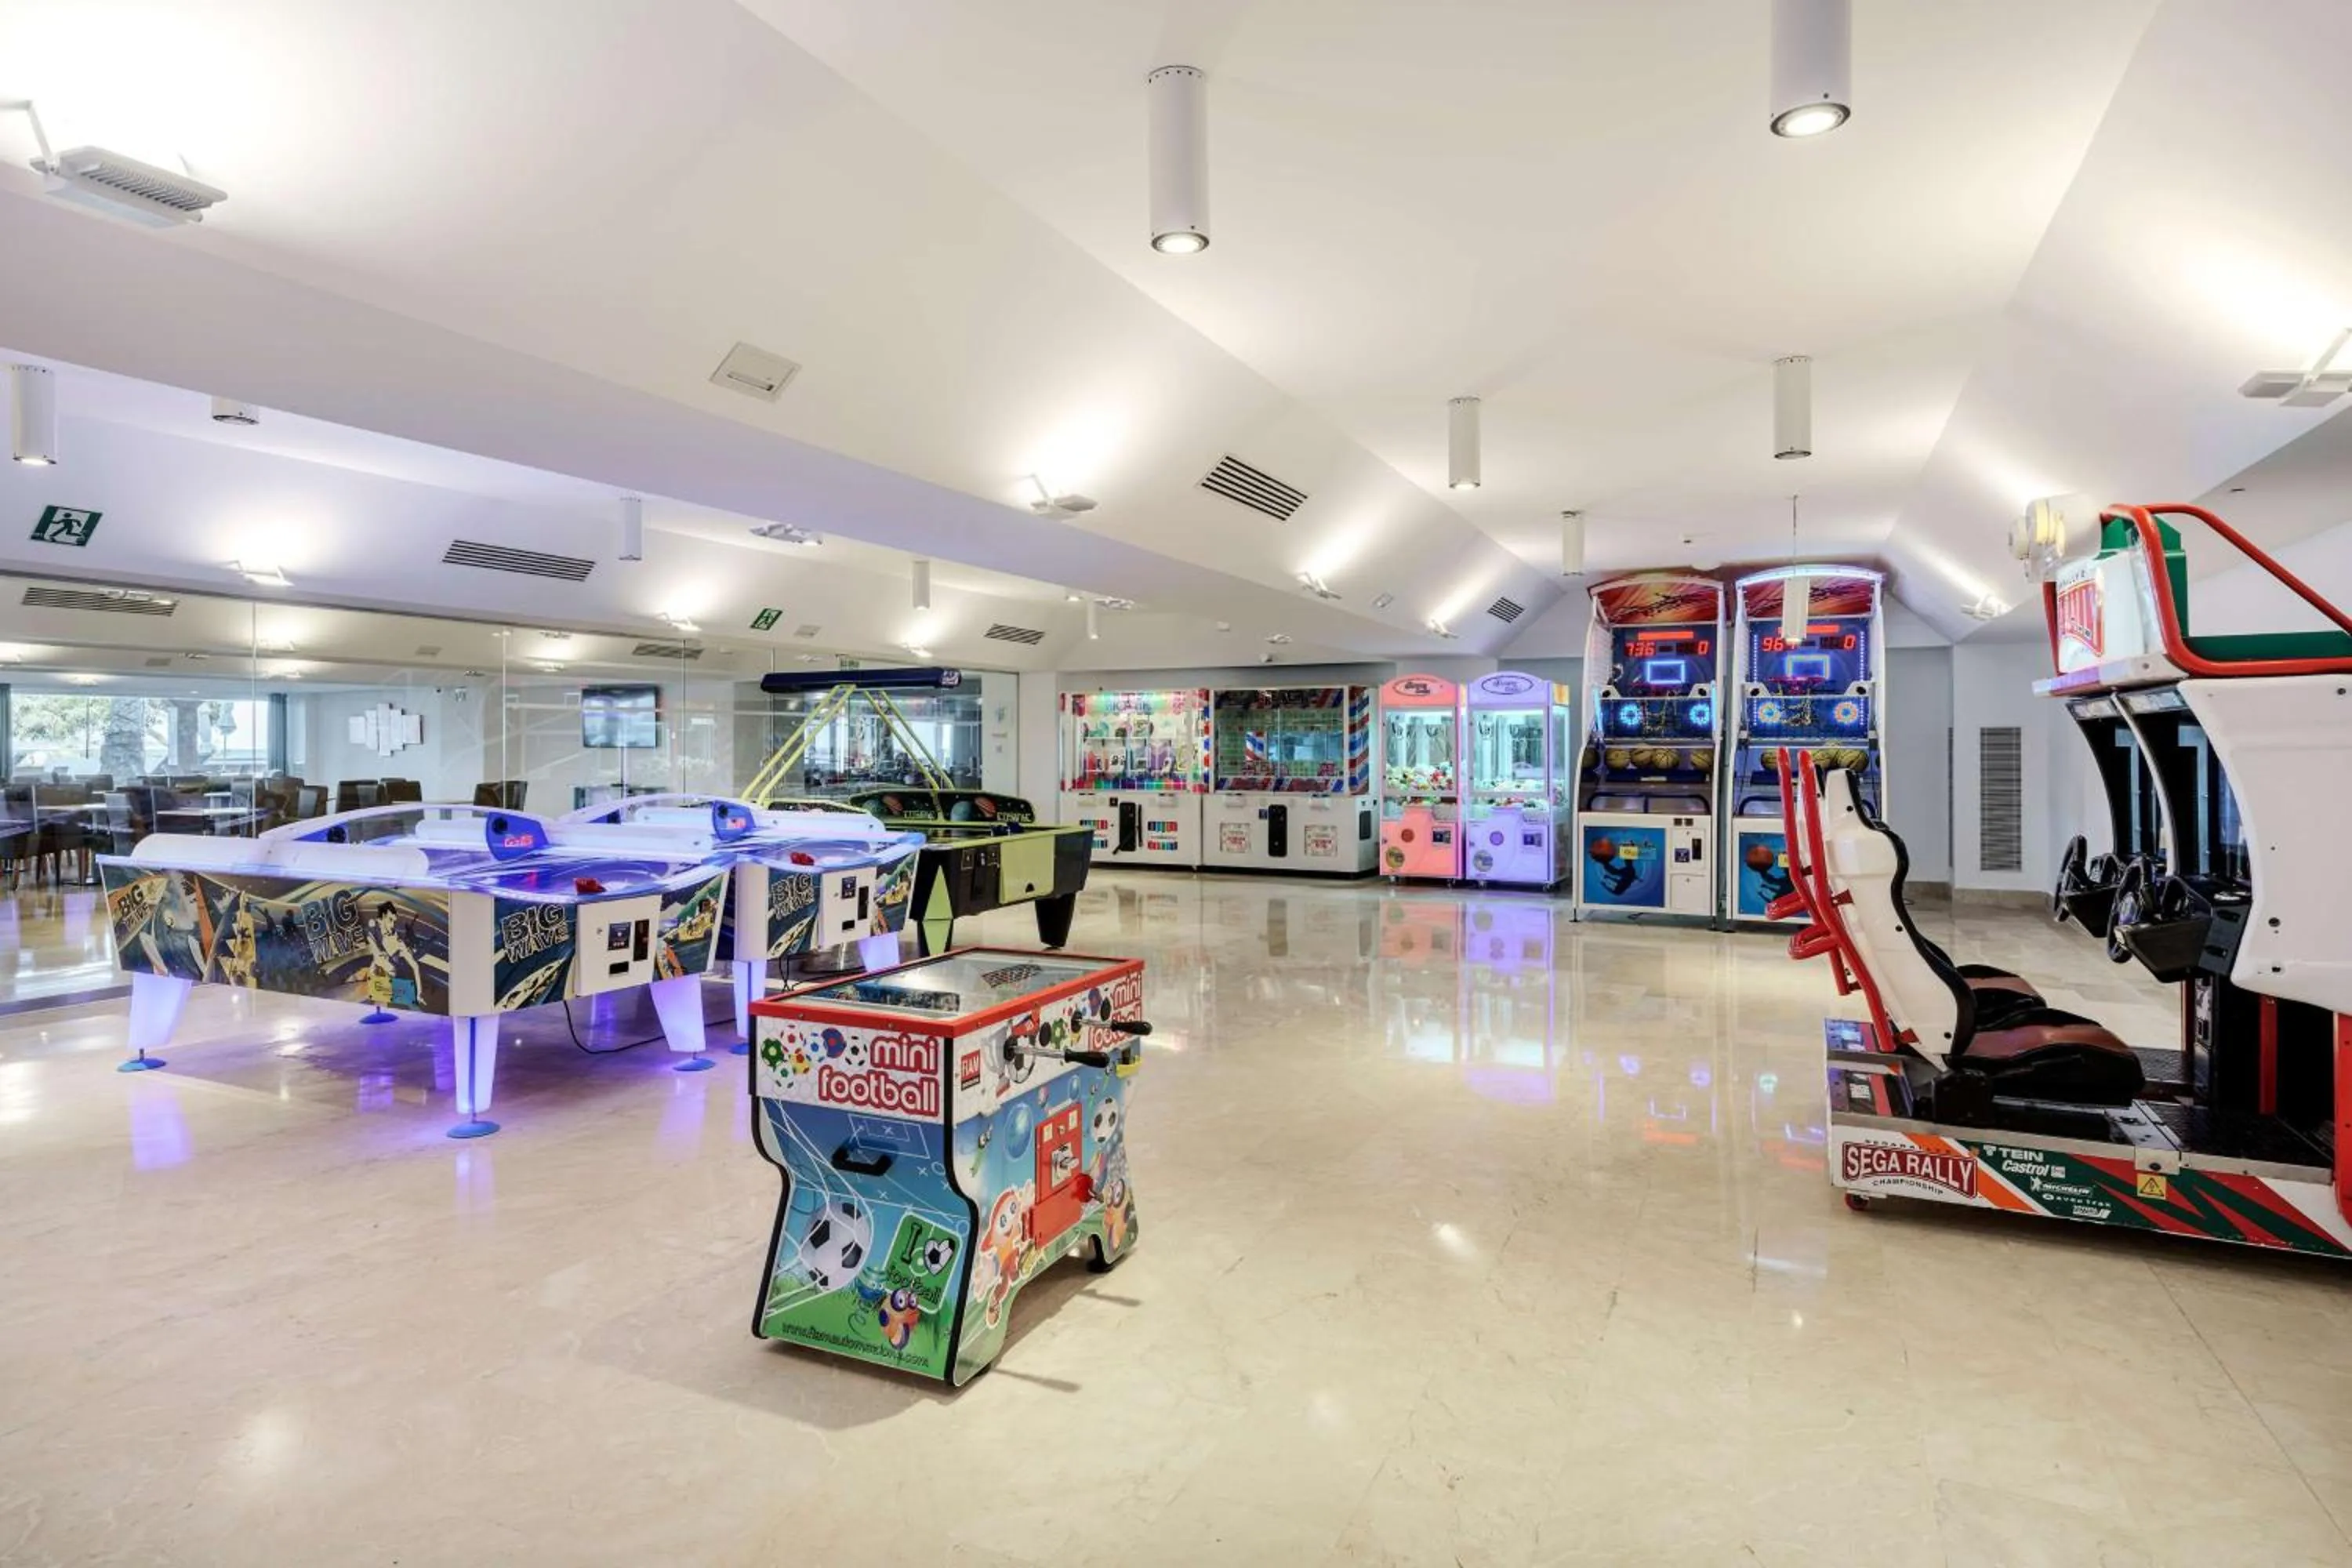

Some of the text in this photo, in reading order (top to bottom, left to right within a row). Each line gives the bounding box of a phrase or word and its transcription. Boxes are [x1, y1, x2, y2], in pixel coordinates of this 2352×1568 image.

[118, 884, 144, 917] BIG
[771, 873, 813, 903] BIG
[301, 890, 359, 941] BIG
[500, 902, 566, 946] BIG
[309, 924, 368, 964] WAVE
[505, 922, 570, 963] WAVE
[1113, 971, 1142, 1010] mini
[871, 1033, 938, 1075] mini
[819, 1065, 939, 1116] football
[1846, 1146, 1973, 1192] SEGA RALLY
[1999, 1147, 2044, 1162] TEIN
[2002, 1160, 2050, 1177] Castrol
[1872, 1178, 1944, 1196] CHAMPIONSHIP
[901, 1222, 923, 1265] I
